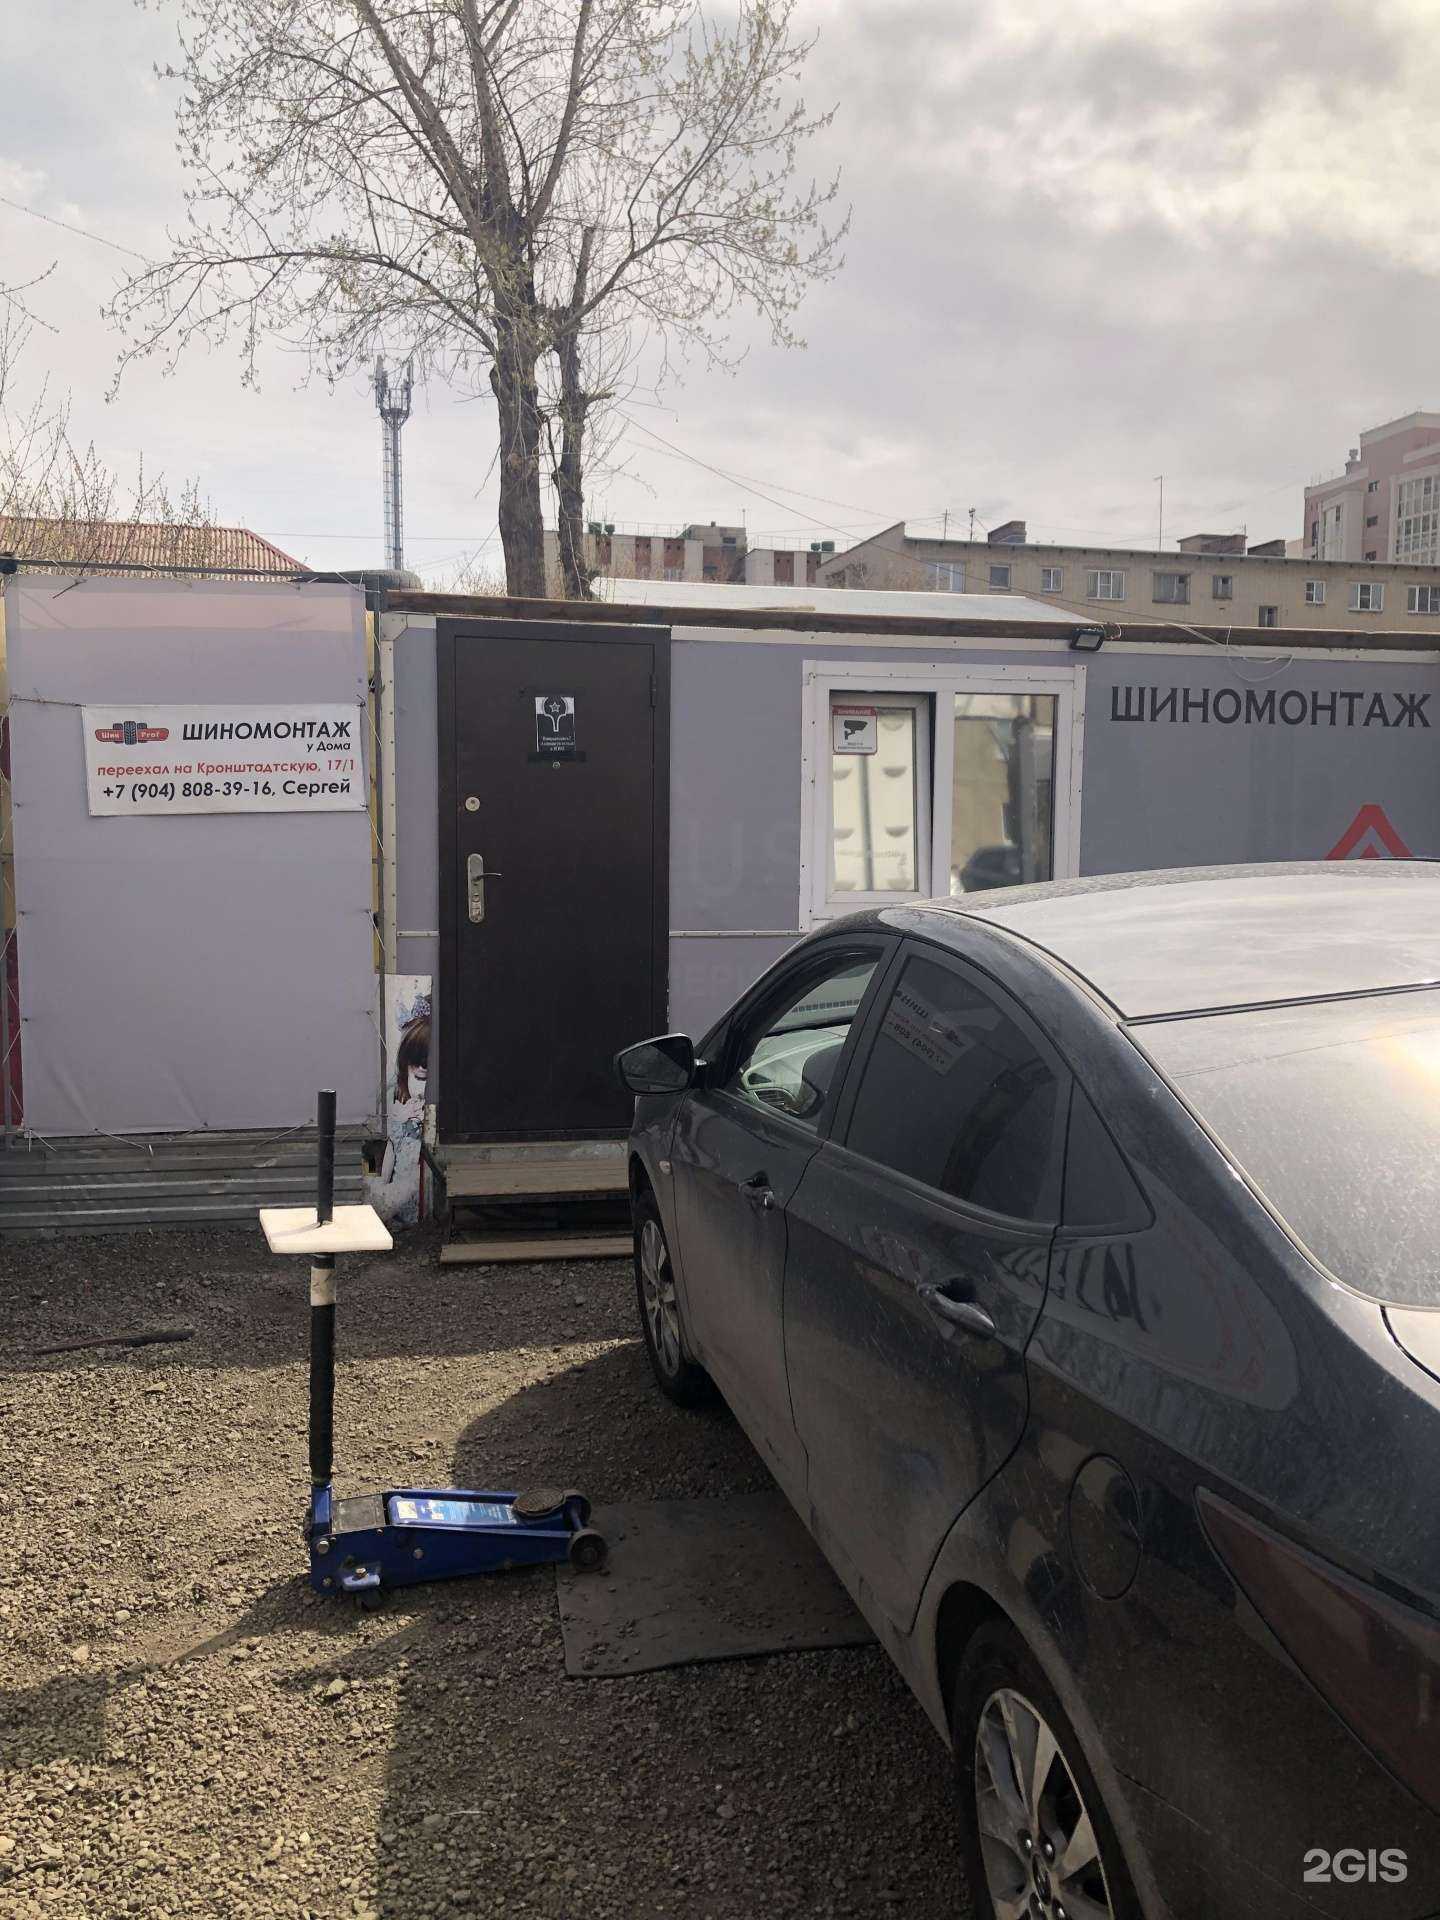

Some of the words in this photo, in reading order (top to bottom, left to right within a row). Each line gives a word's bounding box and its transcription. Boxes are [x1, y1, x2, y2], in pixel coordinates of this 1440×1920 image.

[1110, 686, 1431, 728] ШИНОМОНТАЖ
[182, 721, 351, 741] ШИНОМОНТАЖ
[306, 743, 314, 752] у
[316, 740, 351, 752] Дома
[97, 766, 169, 778] переехал
[174, 765, 192, 774] на
[327, 759, 354, 772] 17/1
[103, 784, 125, 799] +7
[131, 782, 175, 802] (904)
[182, 780, 276, 798] 808-39-16,
[282, 778, 351, 798] Сергей
